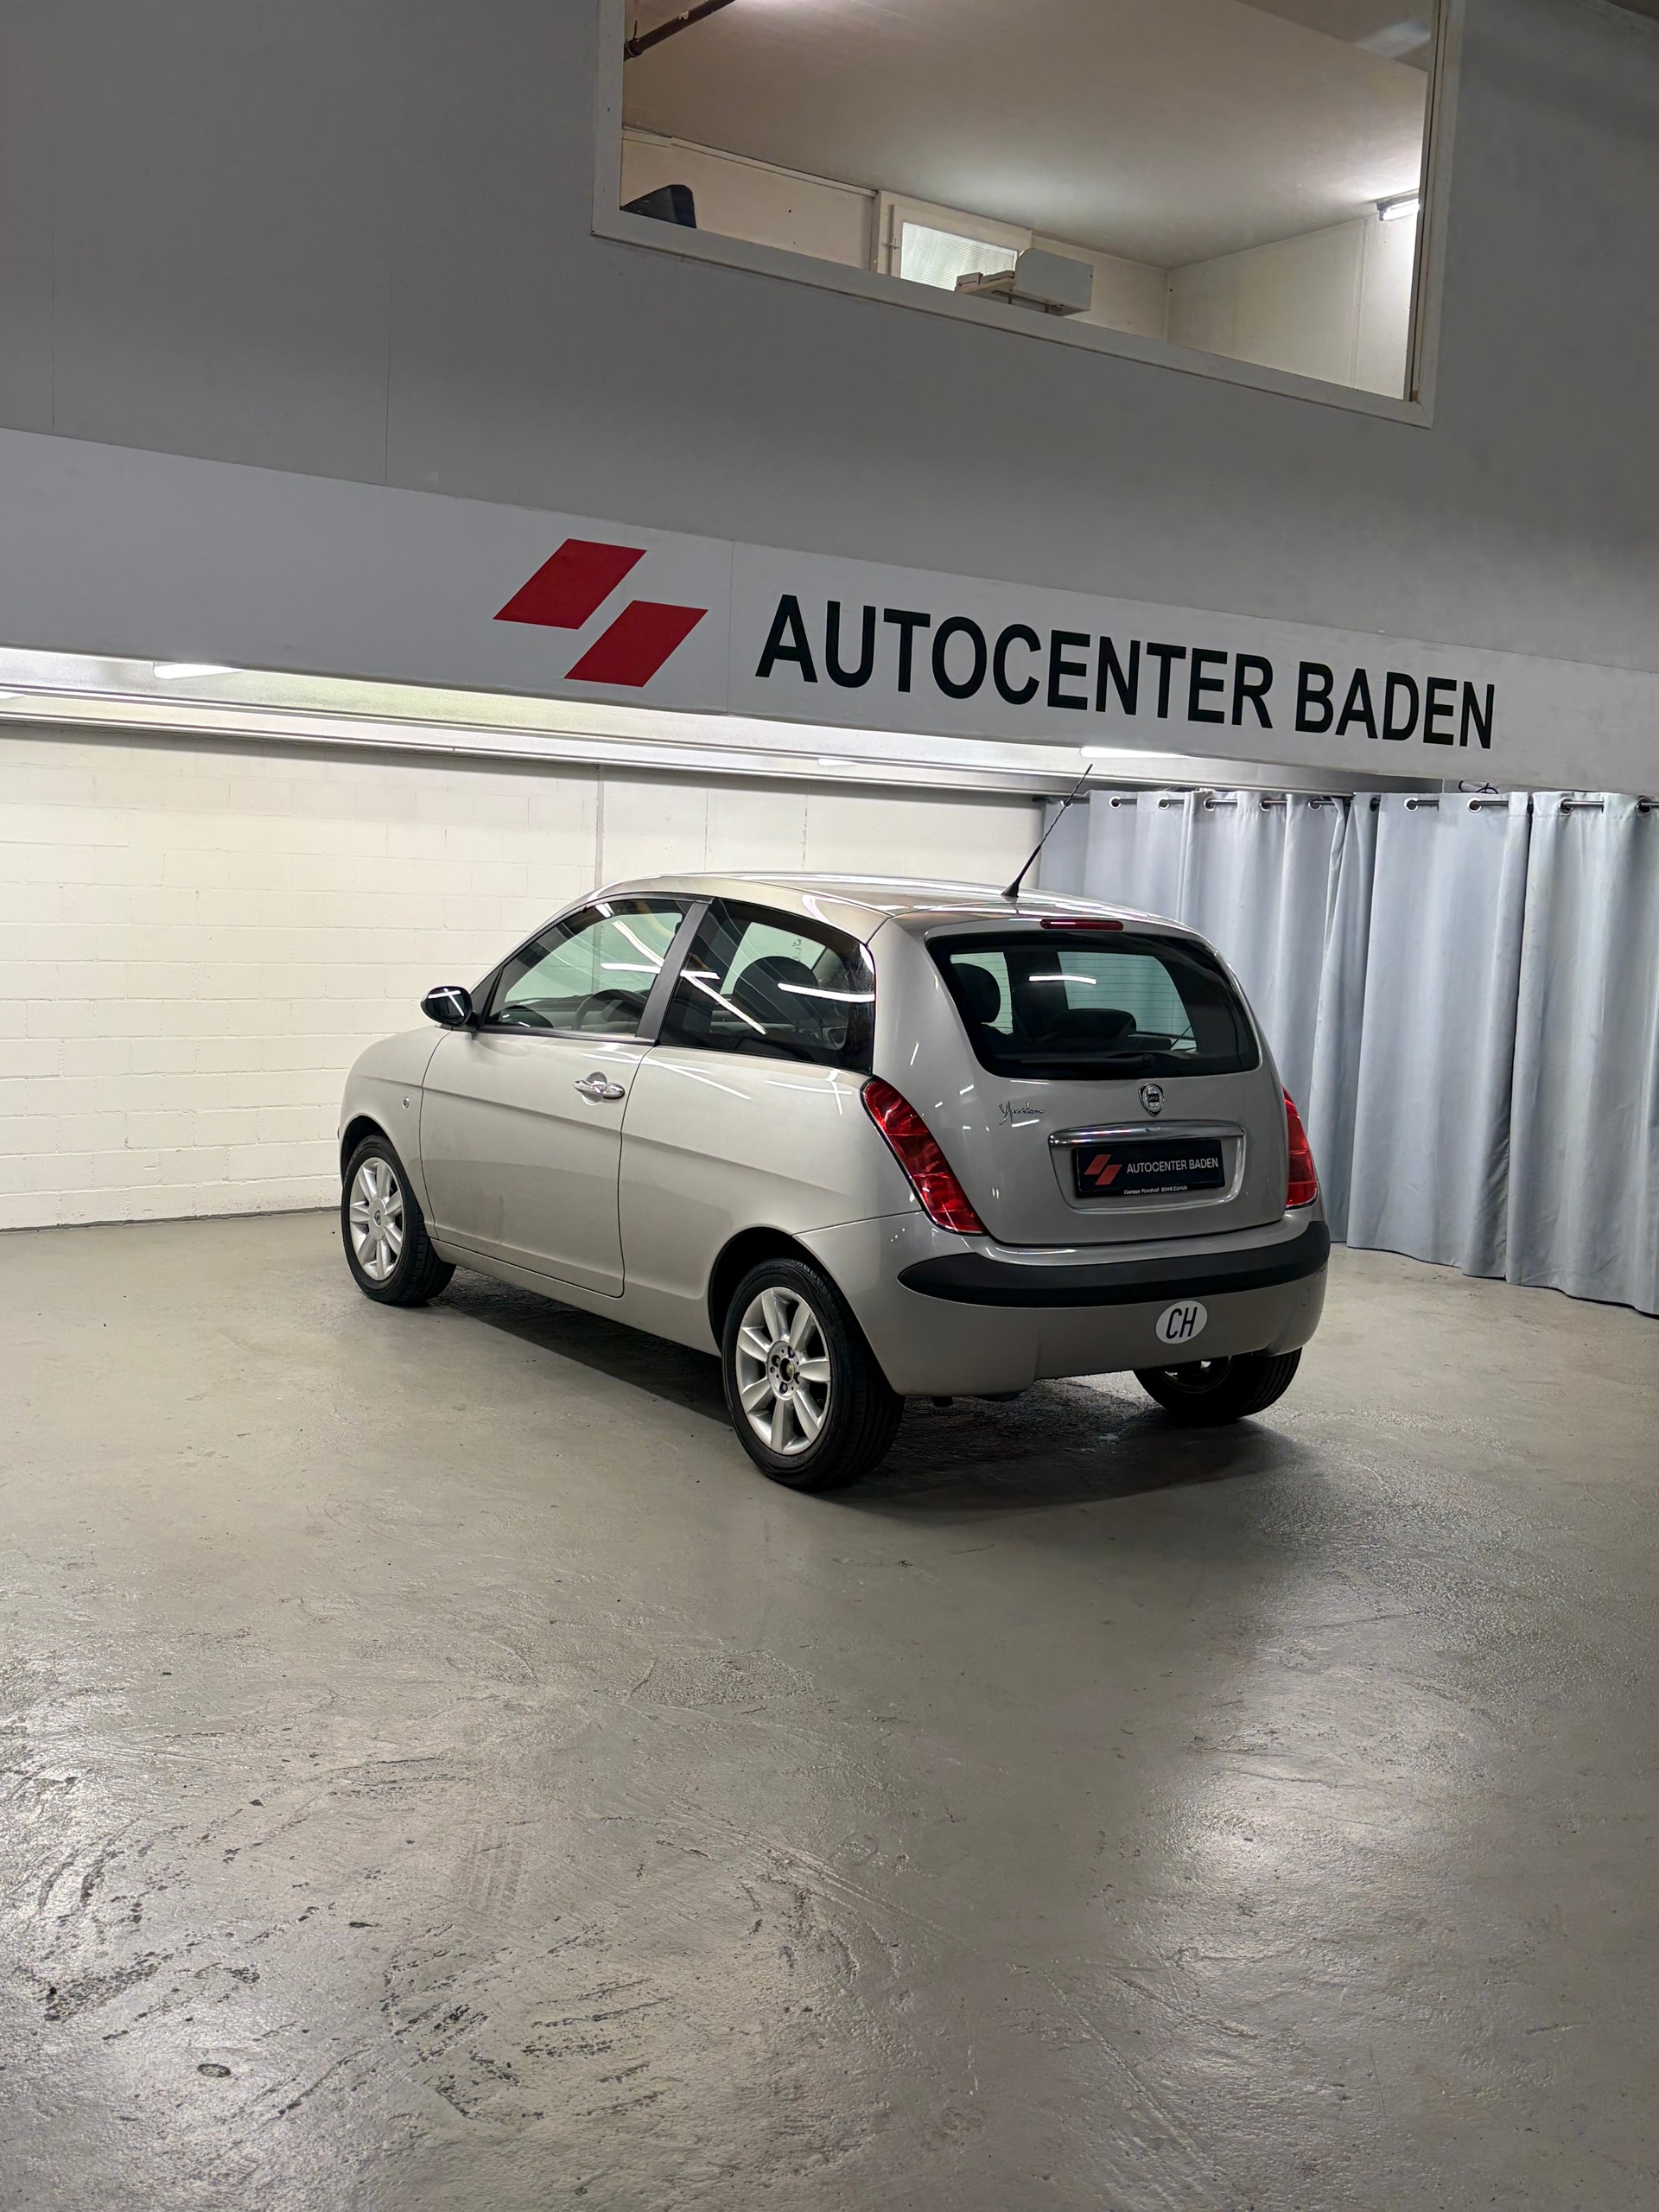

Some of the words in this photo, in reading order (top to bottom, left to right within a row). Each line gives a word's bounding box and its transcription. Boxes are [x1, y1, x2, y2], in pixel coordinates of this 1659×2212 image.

[755, 594, 1274, 729] AUTOCENTER
[1294, 661, 1495, 749] BADEN
[1126, 1160, 1187, 1173] AUTOCENTER
[1189, 1157, 1218, 1170] BADEN
[1166, 1306, 1198, 1339] CH
